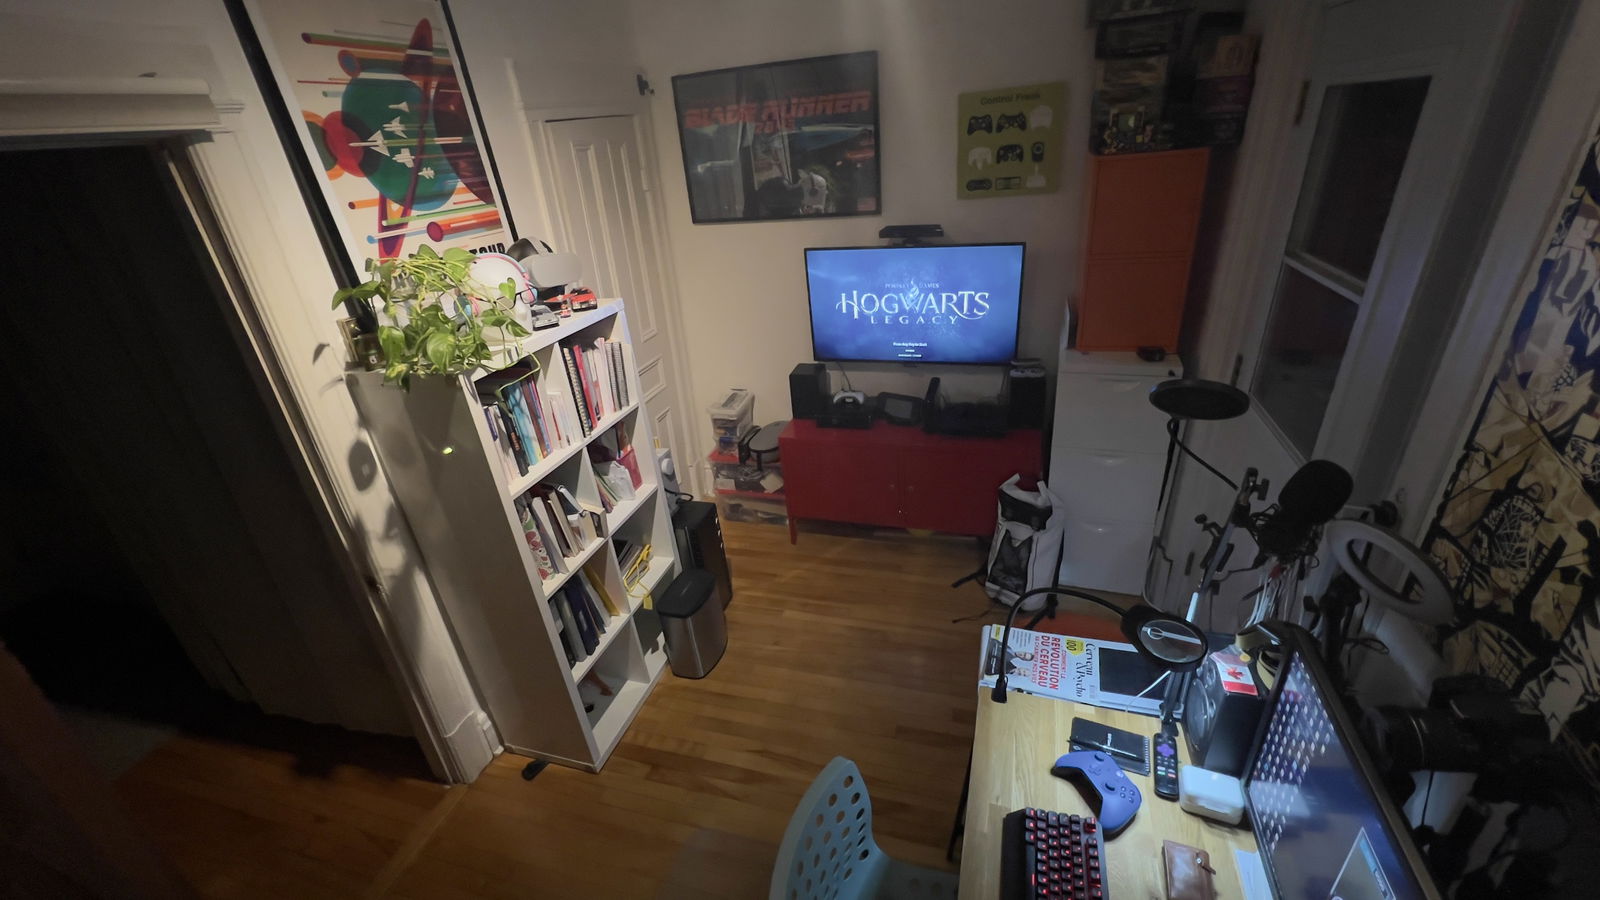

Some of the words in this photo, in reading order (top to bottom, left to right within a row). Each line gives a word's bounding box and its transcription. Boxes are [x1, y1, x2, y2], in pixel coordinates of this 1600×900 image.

[684, 103, 757, 128] BLADE
[761, 90, 872, 121] RUNNER
[980, 94, 1014, 106] Control
[836, 290, 990, 320] HOGWARTS
[870, 315, 959, 325] LEGACY
[1041, 635, 1050, 647] DU
[1066, 639, 1077, 652] 100
[1038, 648, 1050, 688] CERVEAU
[1085, 642, 1097, 676] Cerveau
